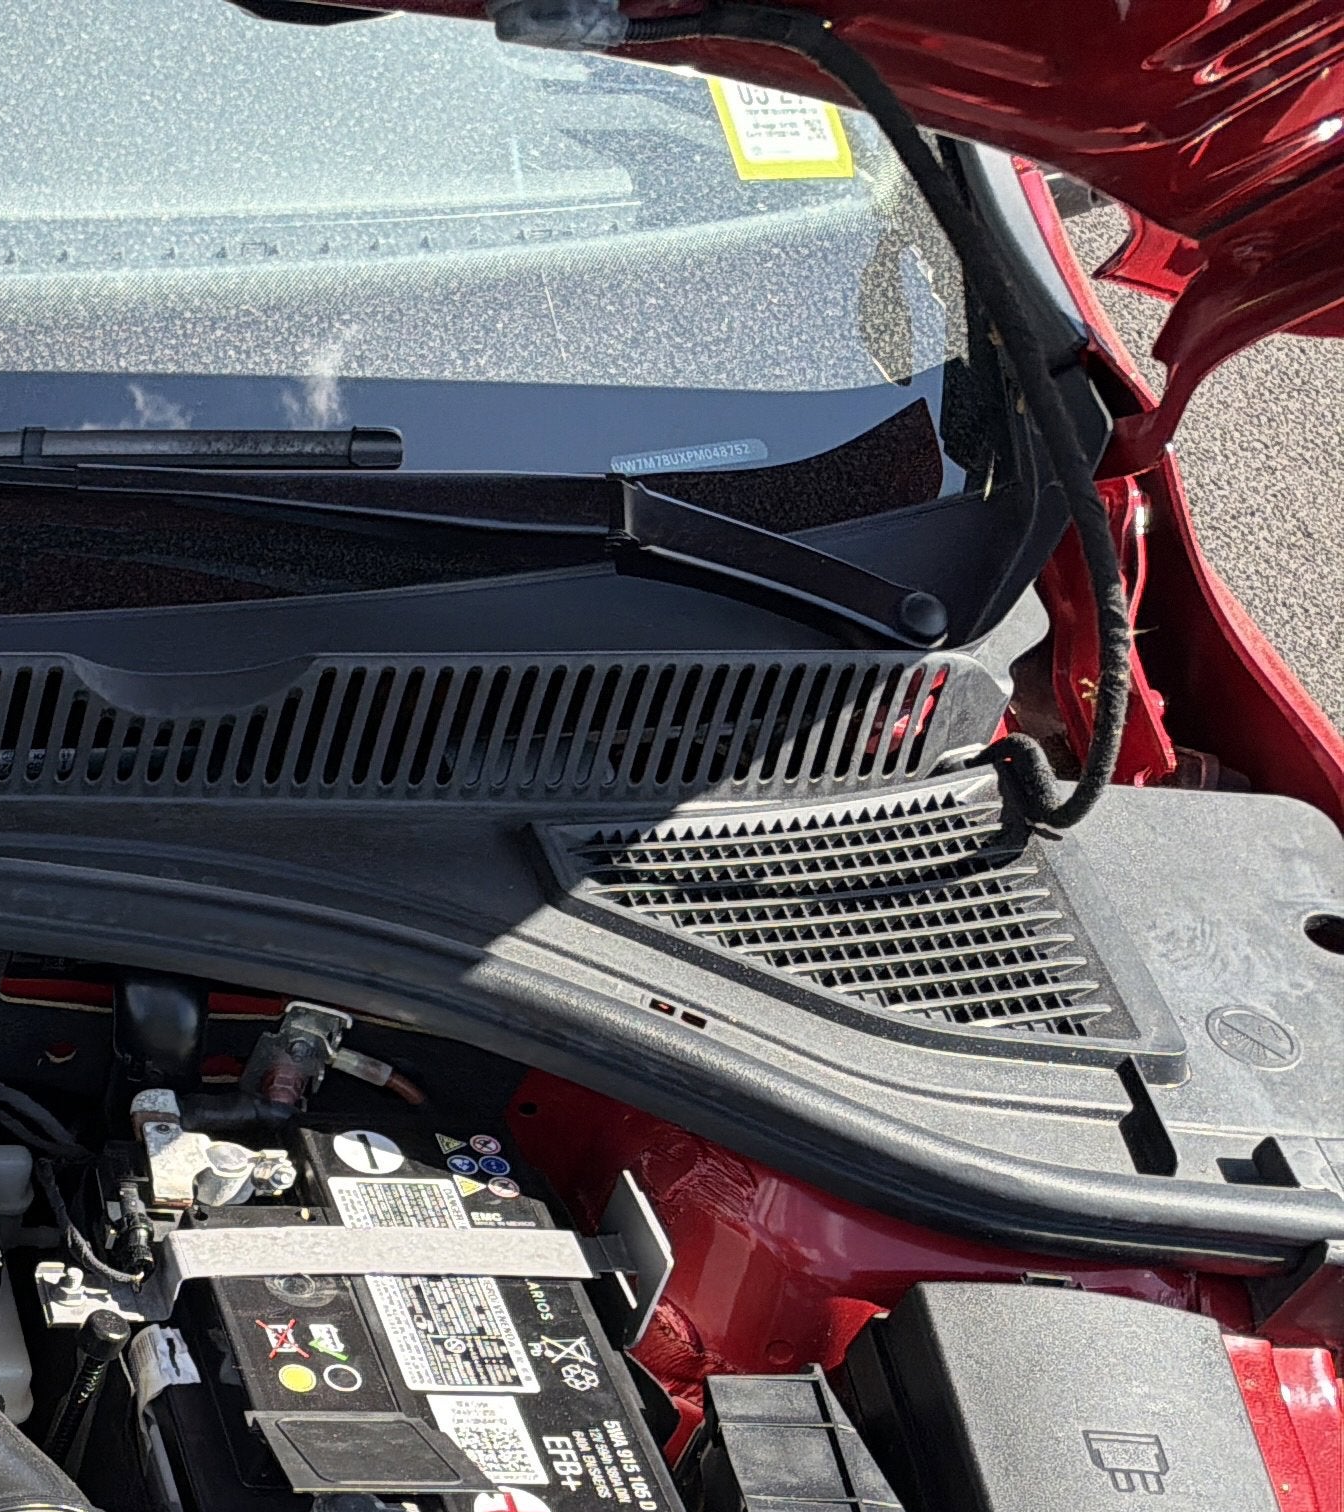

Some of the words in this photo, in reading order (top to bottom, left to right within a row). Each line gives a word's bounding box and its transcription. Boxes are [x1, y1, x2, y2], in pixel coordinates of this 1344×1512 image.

[524, 1279, 554, 1320] ARIOS
[588, 1428, 605, 1443] 12V
[603, 1420, 628, 1447] 5WA
[542, 1436, 583, 1492] EFB+
[616, 1449, 641, 1473] 915
[628, 1476, 652, 1499] 105
[639, 1501, 657, 1510] D
